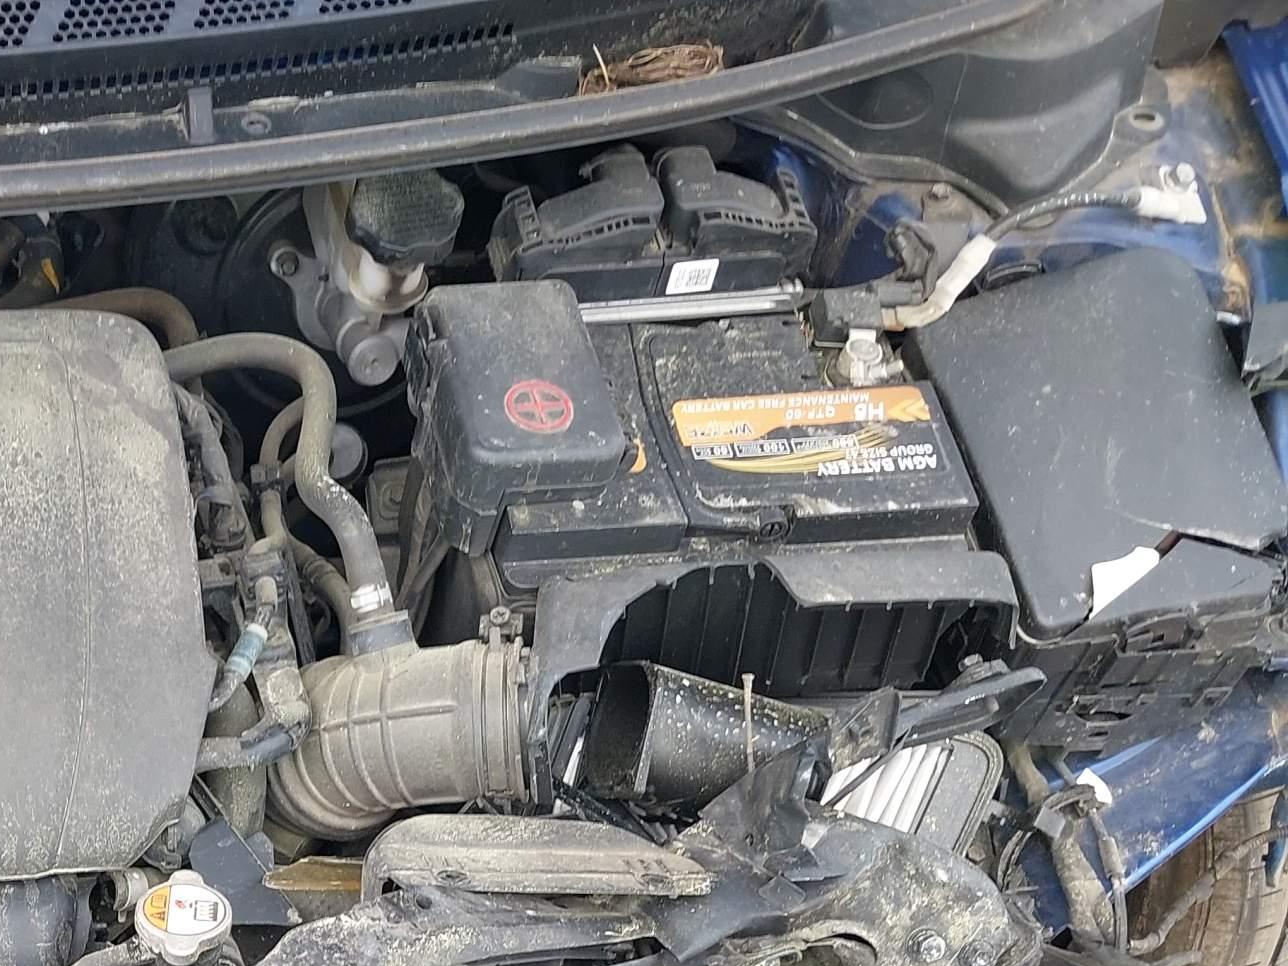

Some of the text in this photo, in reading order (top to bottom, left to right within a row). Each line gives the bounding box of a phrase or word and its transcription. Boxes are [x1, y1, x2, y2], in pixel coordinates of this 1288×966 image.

[680, 400, 731, 414] BATTERY
[733, 399, 755, 411] CAR
[788, 392, 870, 408] MAINTENANCE
[859, 446, 888, 459] SIZE
[890, 443, 933, 457] GROUP
[817, 454, 937, 477] AGM BATTERY
